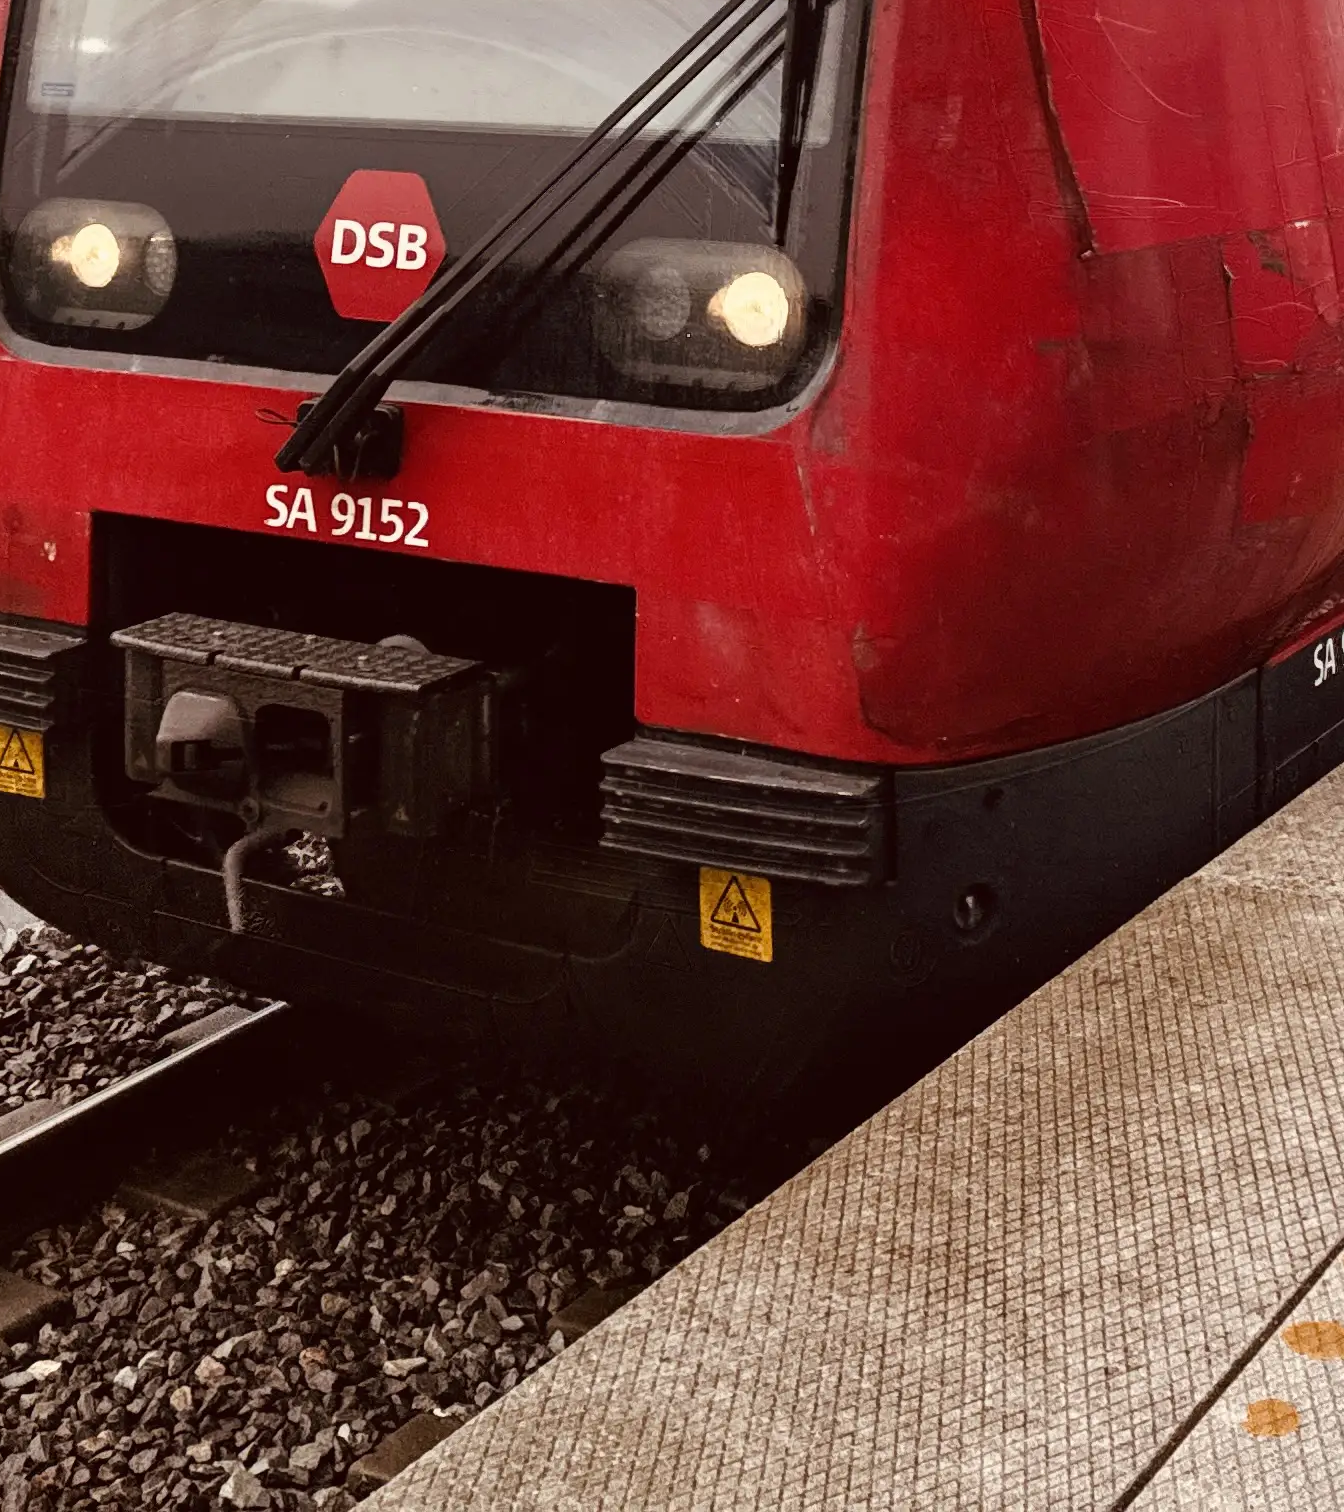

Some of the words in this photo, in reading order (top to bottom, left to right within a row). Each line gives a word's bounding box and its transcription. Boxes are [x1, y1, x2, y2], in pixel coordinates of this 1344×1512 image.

[331, 219, 428, 271] DSB
[264, 484, 317, 532] SA
[331, 492, 429, 548] 9152
[1313, 638, 1336, 686] SA
